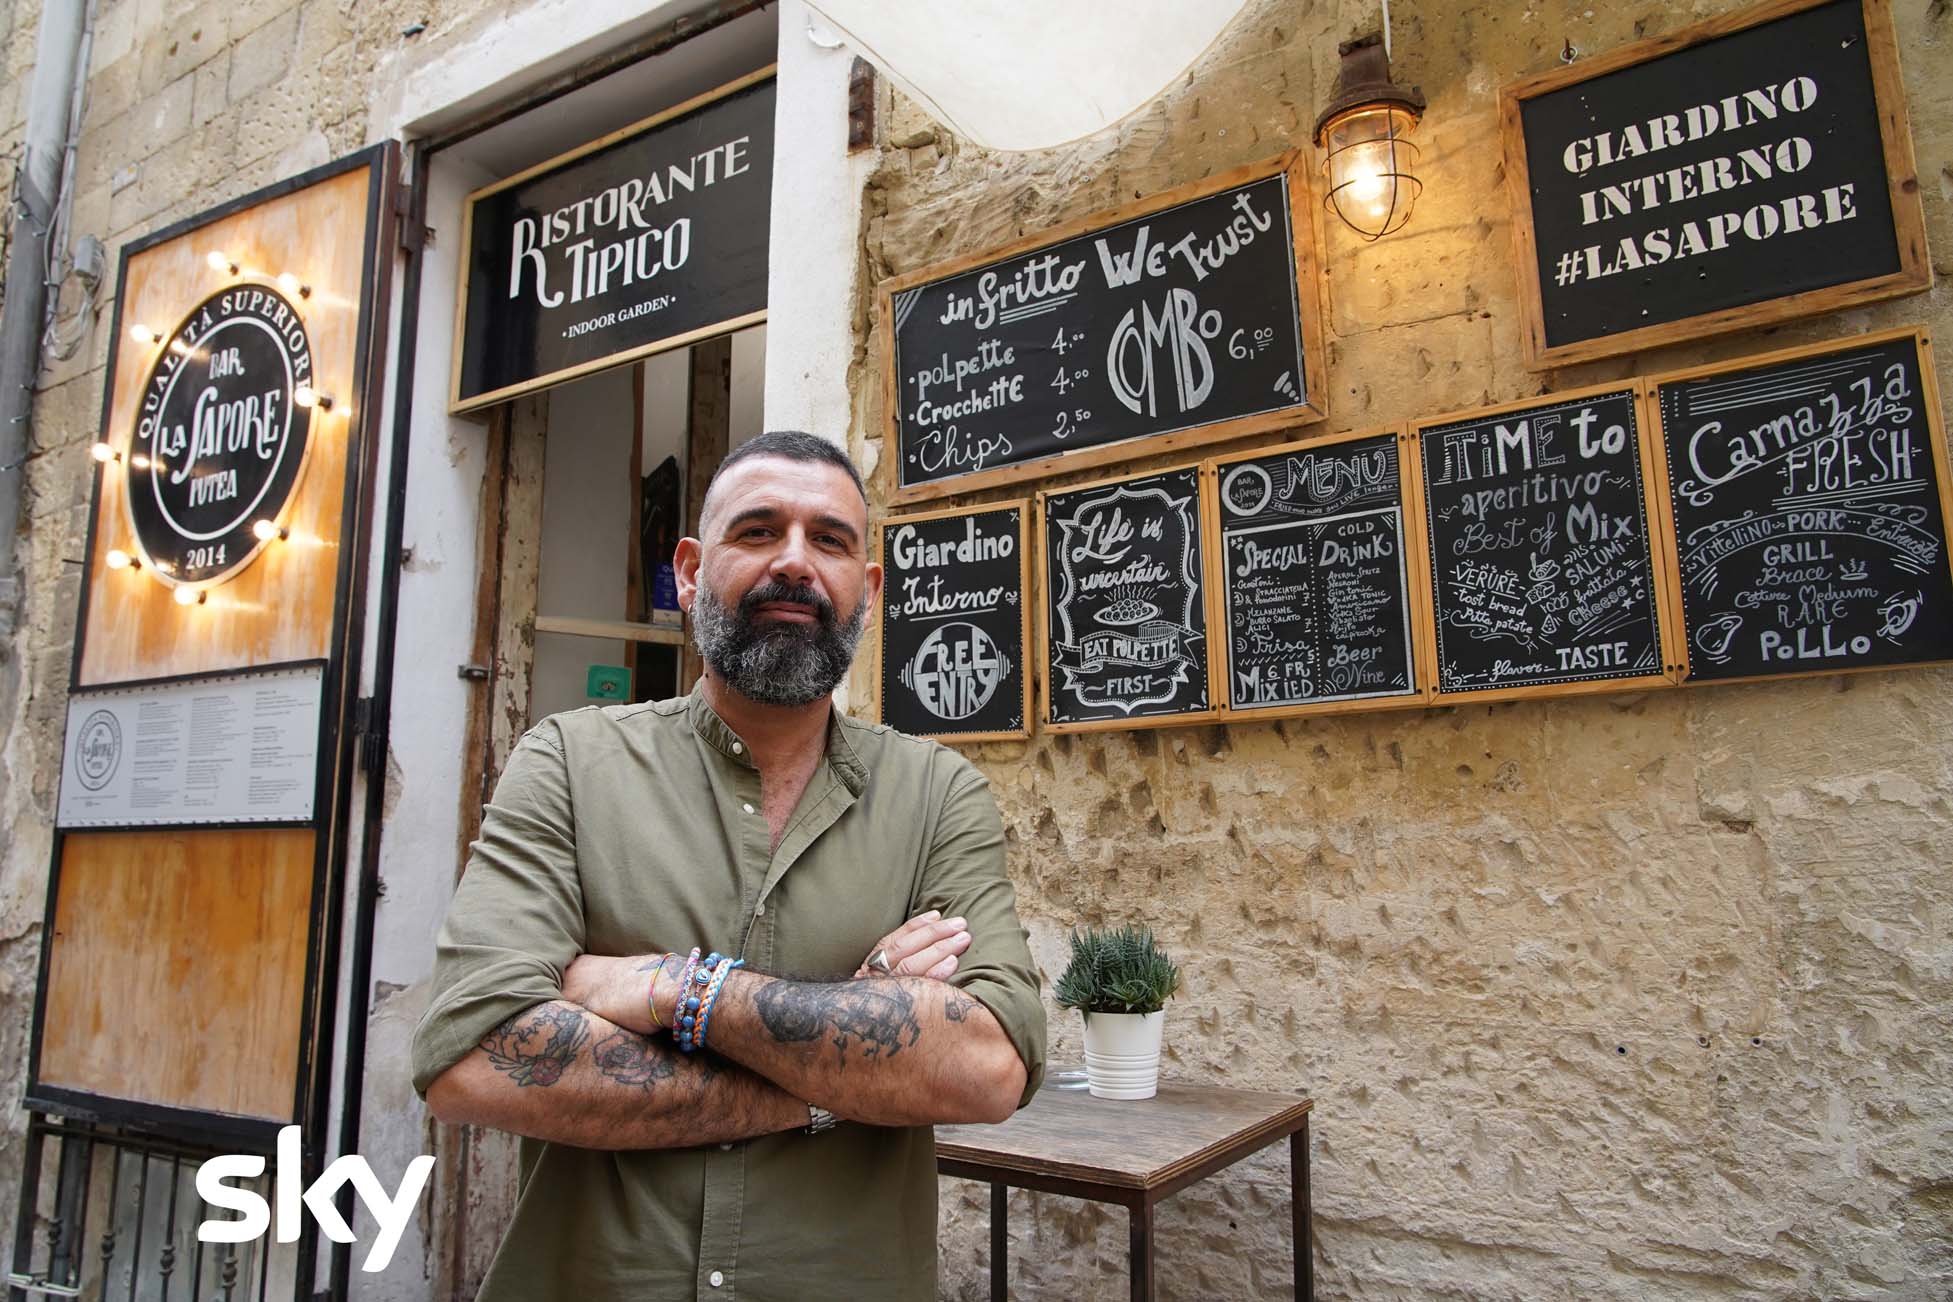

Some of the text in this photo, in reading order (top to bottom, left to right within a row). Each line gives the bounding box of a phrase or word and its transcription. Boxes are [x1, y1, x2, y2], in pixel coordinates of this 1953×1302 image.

[1563, 76, 1818, 175] GIARDINO
[1580, 137, 1813, 226] INTERNO
[510, 136, 750, 308] RISTORANTE
[1168, 192, 1272, 282] Trust
[1554, 183, 1857, 286] #LASAPORE
[565, 218, 691, 304] TIPICO
[568, 295, 669, 338] INDOOR GARDEN
[139, 306, 213, 439] QUALTÀ
[209, 347, 245, 380] BAR
[160, 424, 187, 457] LA
[912, 424, 1013, 473] Chips
[1570, 408, 1626, 459] to
[1279, 451, 1387, 502] MENU
[1783, 428, 1913, 495] FRESH
[1461, 469, 1611, 521] aperitivo
[1072, 508, 1164, 563] Life is
[1338, 522, 1375, 536] COLD
[1530, 512, 1558, 555] of
[1566, 501, 1634, 545] Mix
[1787, 511, 1847, 532] PORK
[186, 544, 227, 571] 2014
[893, 518, 1014, 570] Giardino
[1236, 541, 1307, 577] SPECIAL
[1763, 539, 1834, 566] GRILL
[1756, 567, 1832, 586] Brace
[1799, 582, 1879, 605] Medium
[903, 575, 1004, 615] Interno
[1459, 588, 1527, 616] tost bread
[1273, 614, 1301, 624] SALATO
[1491, 619, 1533, 633] patate
[1777, 601, 1848, 628] RARE
[1083, 637, 1179, 661] EAT POLPETTE
[1327, 645, 1383, 668] Beer
[1555, 641, 1629, 670] TASTE
[1106, 675, 1153, 696] FIRST
[1267, 665, 1278, 678] 6
